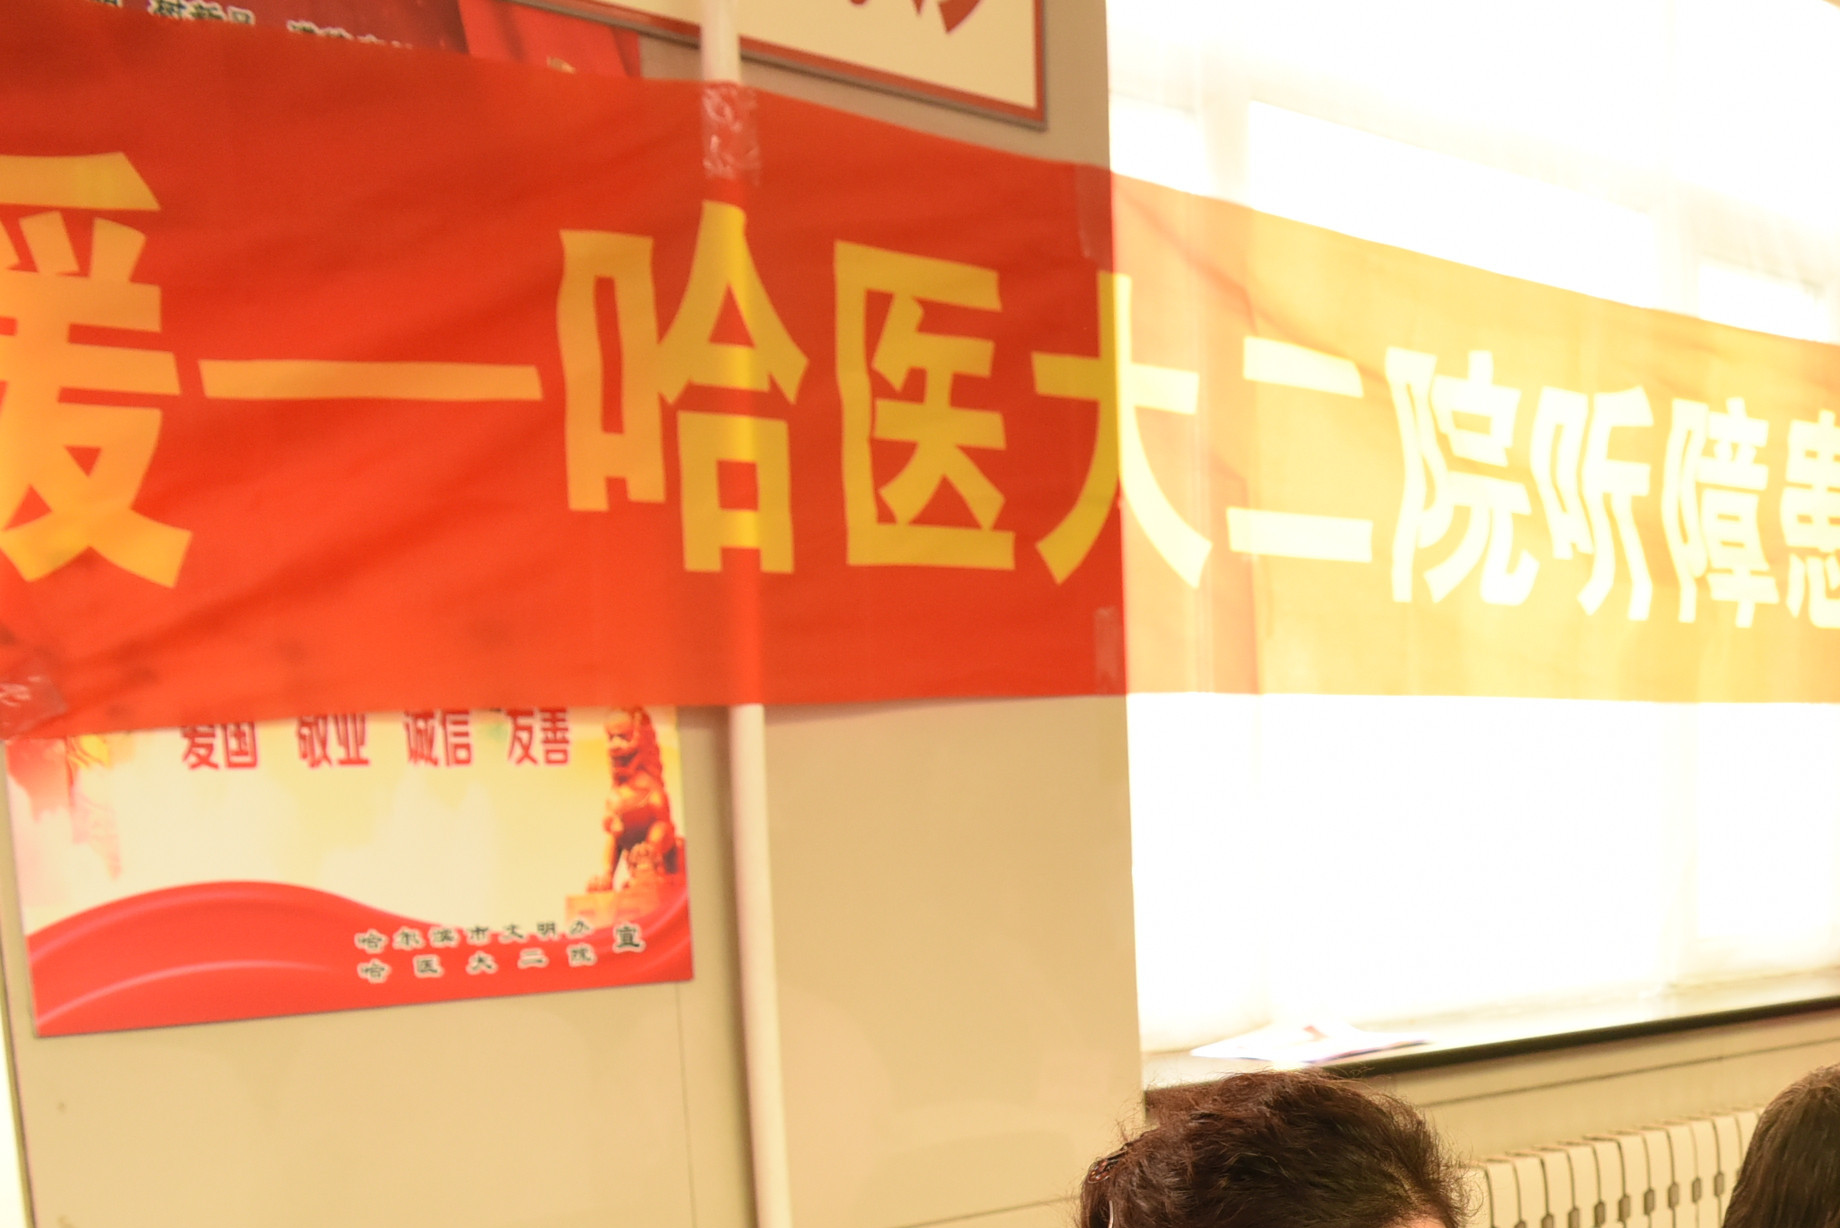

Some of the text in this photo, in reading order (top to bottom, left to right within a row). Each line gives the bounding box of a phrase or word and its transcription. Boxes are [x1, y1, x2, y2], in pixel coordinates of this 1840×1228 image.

[177, 707, 571, 770] 爱国 敬业 诚信 友善
[613, 922, 646, 953] 宣
[357, 943, 598, 984] 哈医大二院
